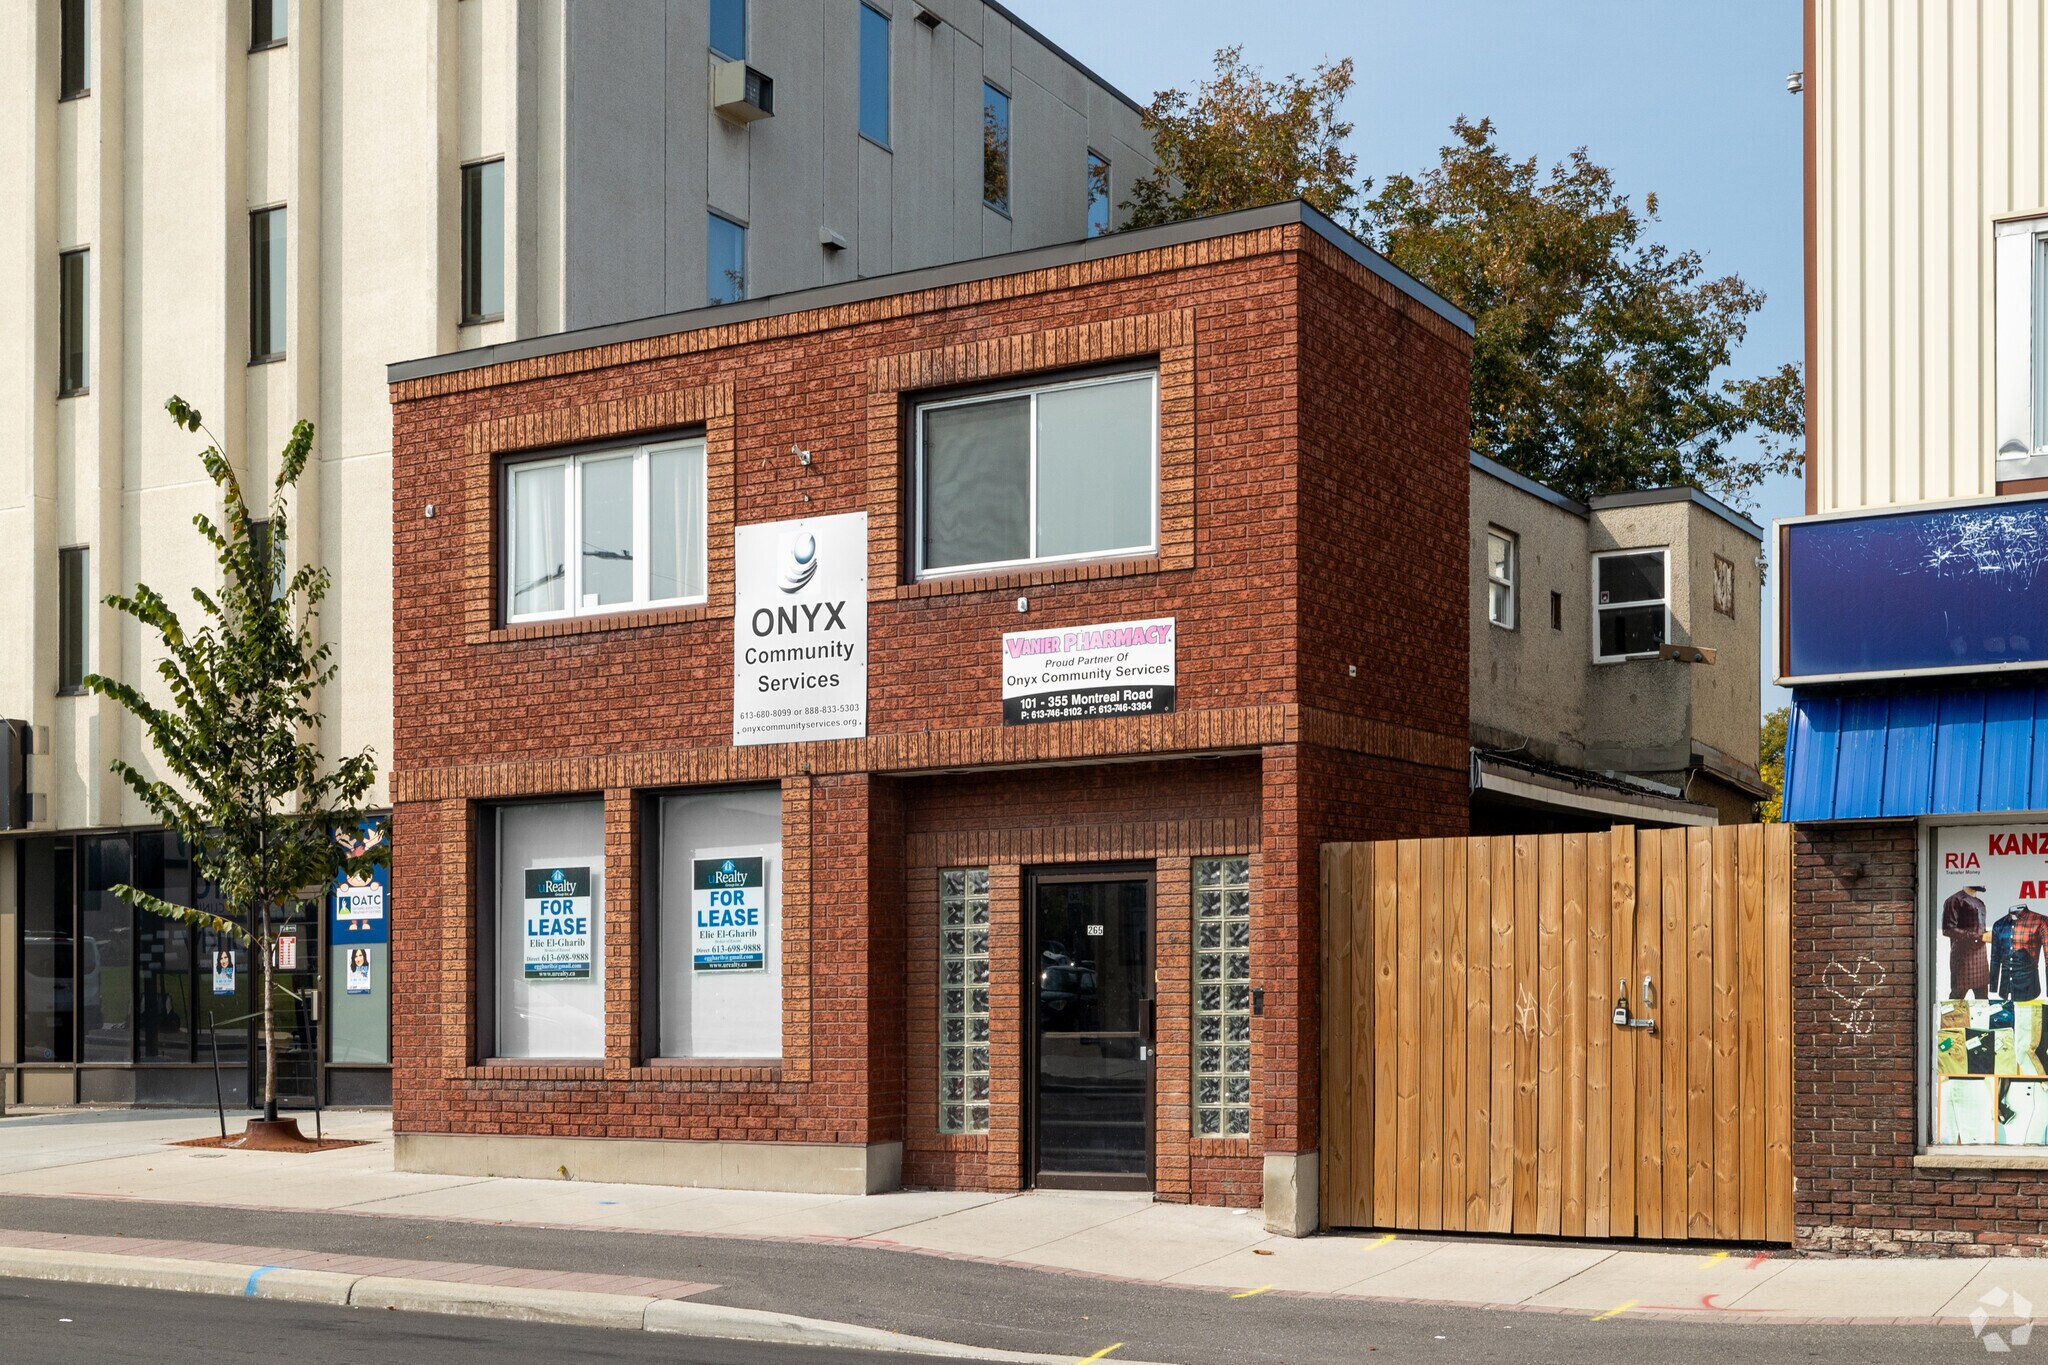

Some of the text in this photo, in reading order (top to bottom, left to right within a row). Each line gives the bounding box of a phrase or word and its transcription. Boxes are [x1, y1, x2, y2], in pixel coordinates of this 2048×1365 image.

[752, 601, 846, 637] ONYX
[1063, 626, 1173, 652] PHARMACY
[745, 641, 855, 665] Community
[1045, 652, 1129, 669] Proud Partner Of
[758, 672, 840, 692] Services
[1006, 664, 1170, 687] Onyx Community Services
[1020, 698, 1037, 709] 101
[1047, 696, 1068, 707] 355
[1071, 691, 1120, 706] Montreal
[1123, 688, 1154, 701] Road
[740, 703, 860, 720] 613-680-8099 or 888-833-5303
[1021, 701, 1152, 720] P: 613-746-8102 F: 613-746-3364
[742, 718, 857, 734] onyxcommunityservices.org
[1988, 832, 2048, 856] KANZ
[1945, 852, 1981, 869] RIA
[708, 870, 748, 887] uRealty
[538, 880, 577, 896] uRealty
[352, 895, 381, 906] OATC
[540, 899, 574, 915] FOR
[710, 890, 745, 907] FOR
[697, 908, 759, 928] LEASE
[528, 917, 587, 937] LEASE
[717, 928, 757, 938] El-Gharib
[1088, 926, 1103, 934] 265
[546, 938, 586, 947] El-Gharib
[711, 944, 762, 953] 613-698-9888
[541, 953, 590, 962] 613-698-9888
